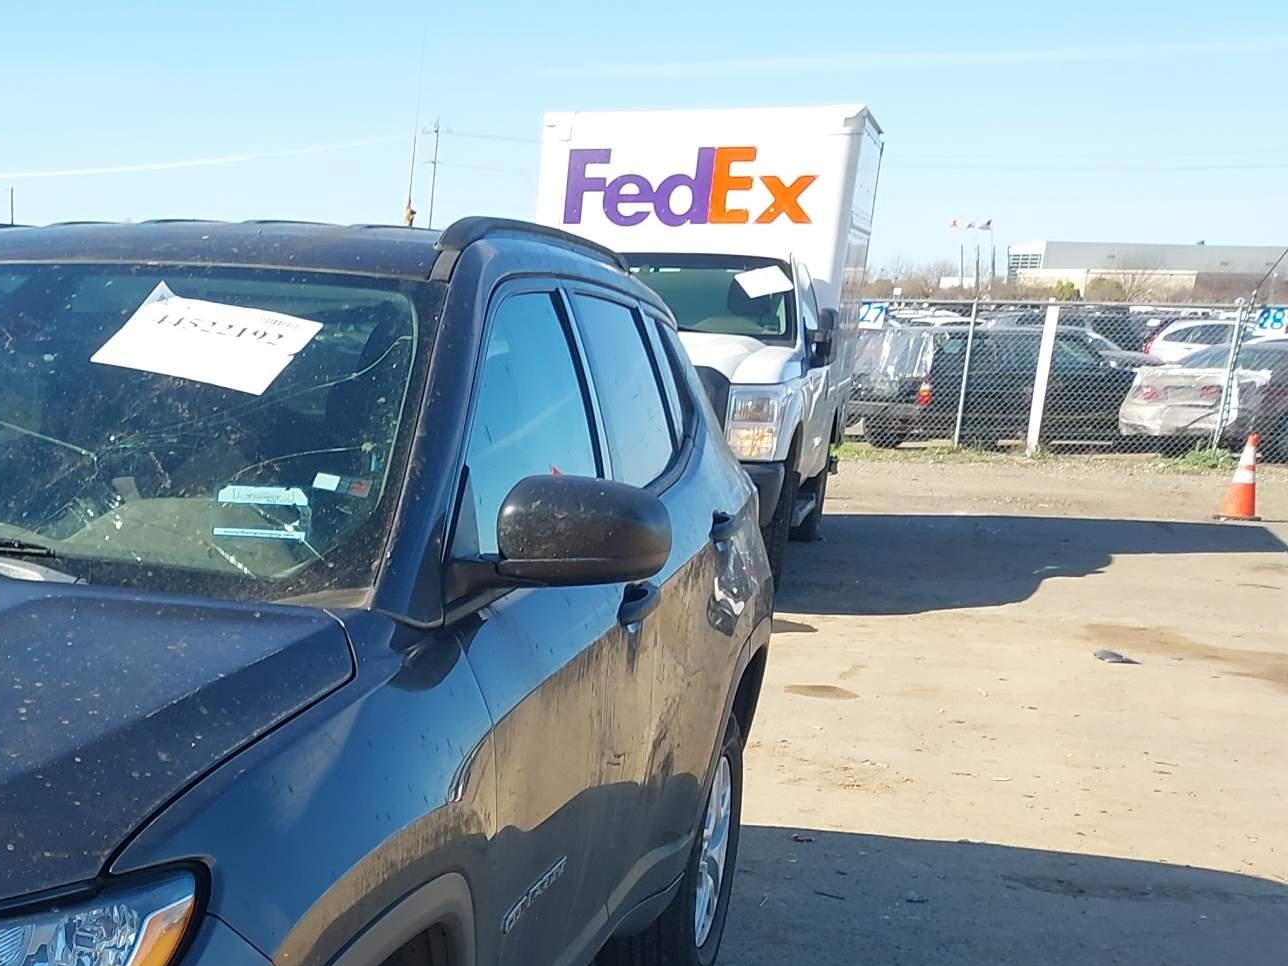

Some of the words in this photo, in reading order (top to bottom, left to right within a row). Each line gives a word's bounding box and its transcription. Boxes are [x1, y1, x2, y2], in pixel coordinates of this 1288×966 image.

[563, 146, 820, 227] FedEx
[858, 302, 884, 323] 27
[1259, 307, 1285, 329] 28
